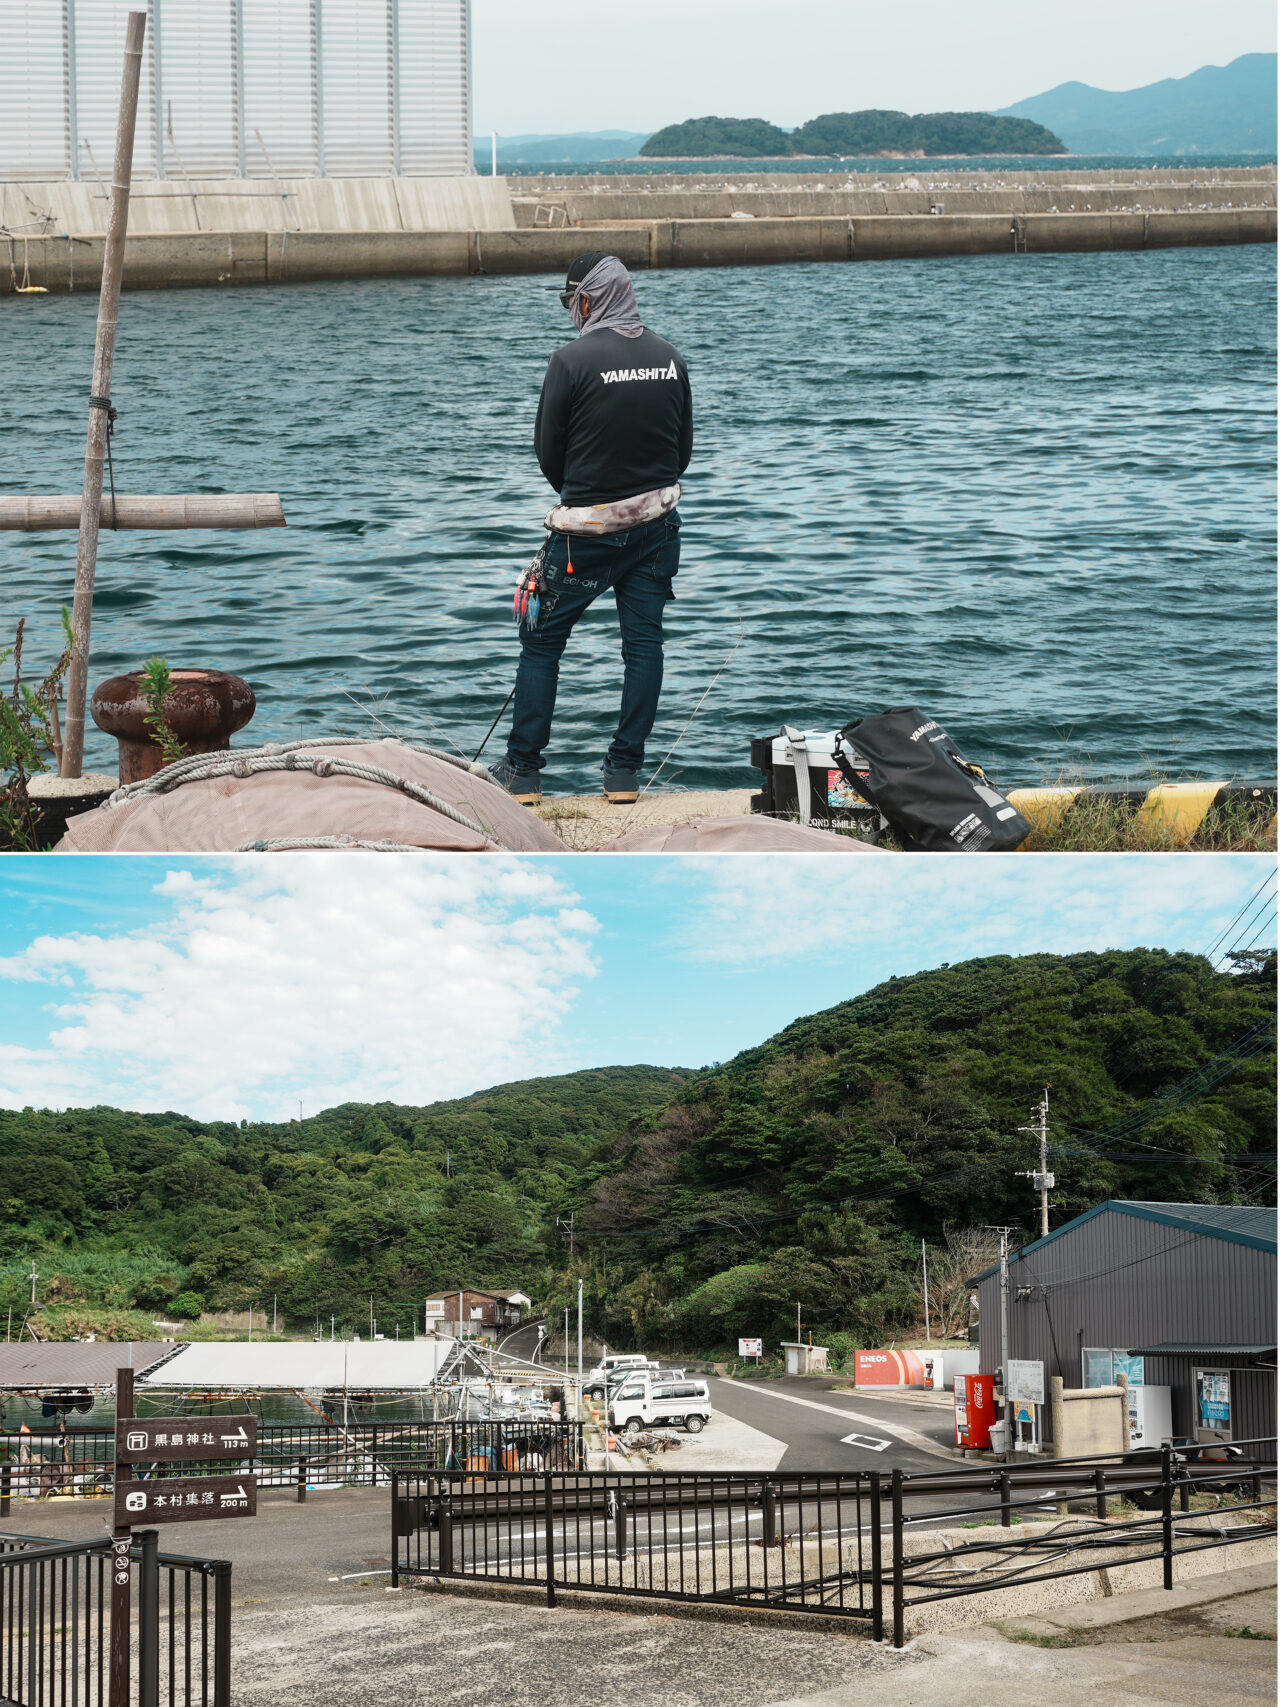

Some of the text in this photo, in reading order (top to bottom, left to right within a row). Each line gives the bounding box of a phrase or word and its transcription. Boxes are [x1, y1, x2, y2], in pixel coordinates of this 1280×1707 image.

[600, 359, 678, 384] YAMASHITA
[860, 1355, 888, 1363] ENEOS
[154, 1432, 215, 1447] 黒島神社
[223, 1440, 238, 1449] 113
[153, 1491, 215, 1508] 本村集落
[220, 1500, 238, 1508] 200
